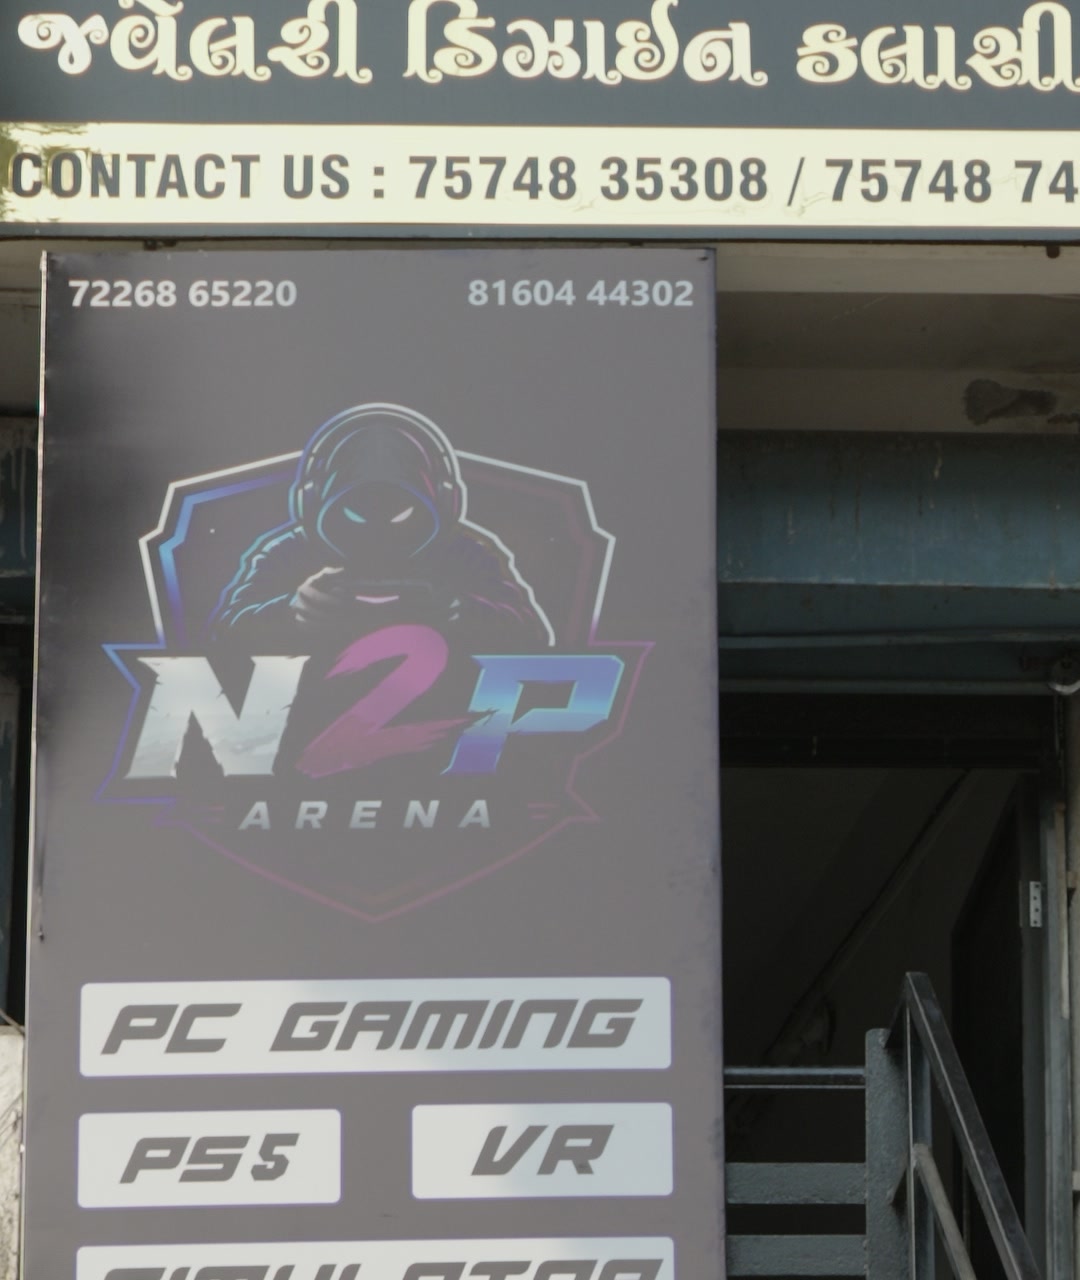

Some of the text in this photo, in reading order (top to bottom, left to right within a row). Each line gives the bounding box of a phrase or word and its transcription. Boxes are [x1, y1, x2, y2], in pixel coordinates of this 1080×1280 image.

[402, 0, 768, 86] ડિઝાઈન
[12, 152, 260, 199] CONTACT
[282, 154, 350, 199] US
[409, 156, 577, 200] 75748
[600, 157, 767, 201] 35308
[825, 158, 992, 204] 75748
[68, 280, 297, 307] 72268 65220
[468, 279, 694, 306] 81604 44302
[123, 624, 625, 779] N2P
[238, 800, 491, 830] ARENA
[101, 998, 644, 1055] PC GAMING
[119, 1133, 300, 1184] PS5
[471, 1124, 614, 1176] VR
